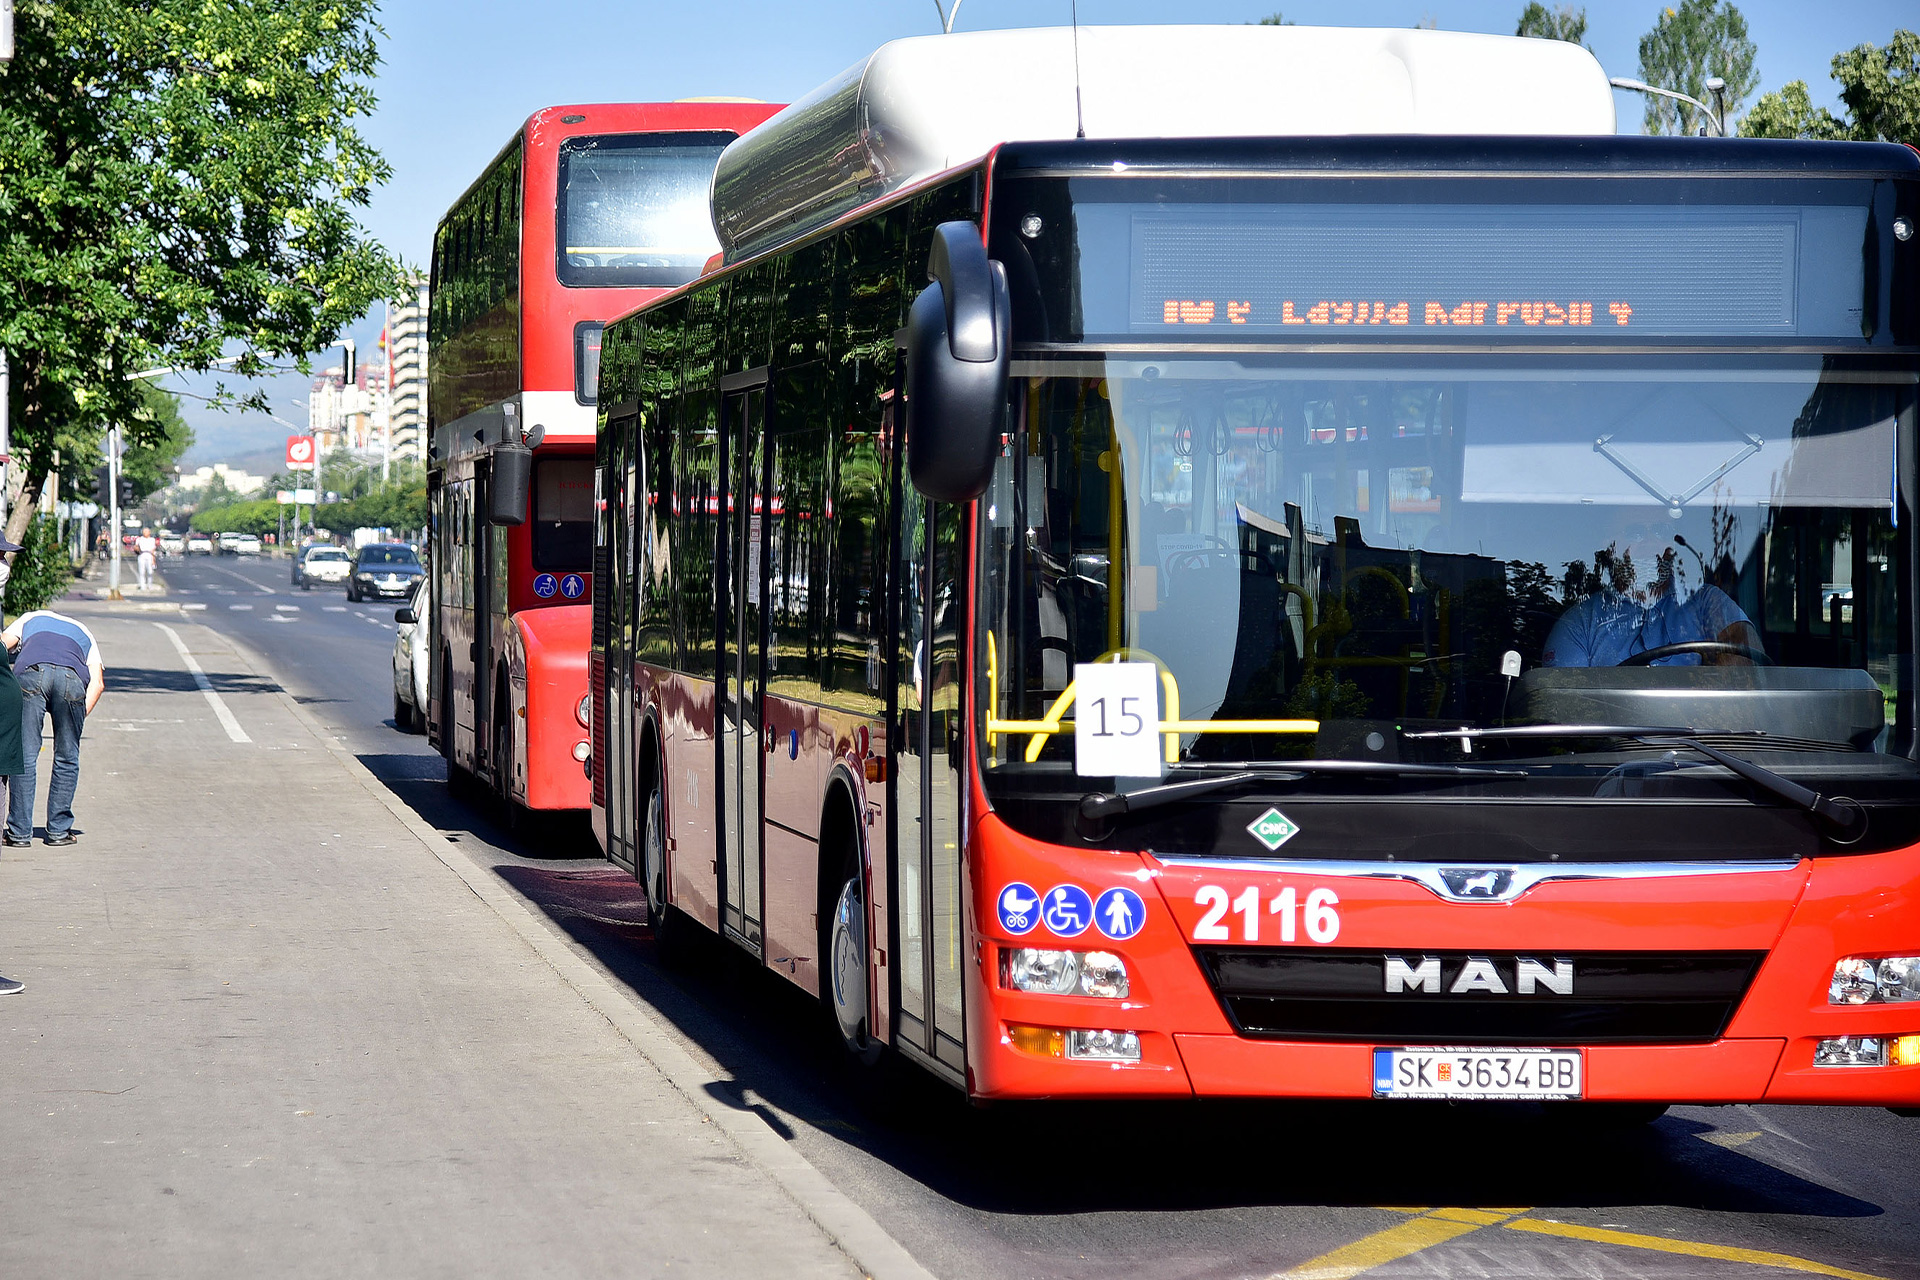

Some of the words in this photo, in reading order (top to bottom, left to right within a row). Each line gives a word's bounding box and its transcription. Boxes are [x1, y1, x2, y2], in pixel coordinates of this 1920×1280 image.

[1091, 697, 1143, 737] 15
[1260, 822, 1288, 835] CNG
[1193, 884, 1340, 944] 2116
[1384, 955, 1574, 995] MAN
[1377, 1079, 1394, 1089] NMK
[1398, 1058, 1433, 1088] SK
[1457, 1058, 1531, 1088] 3634
[1539, 1058, 1574, 1088] BB
